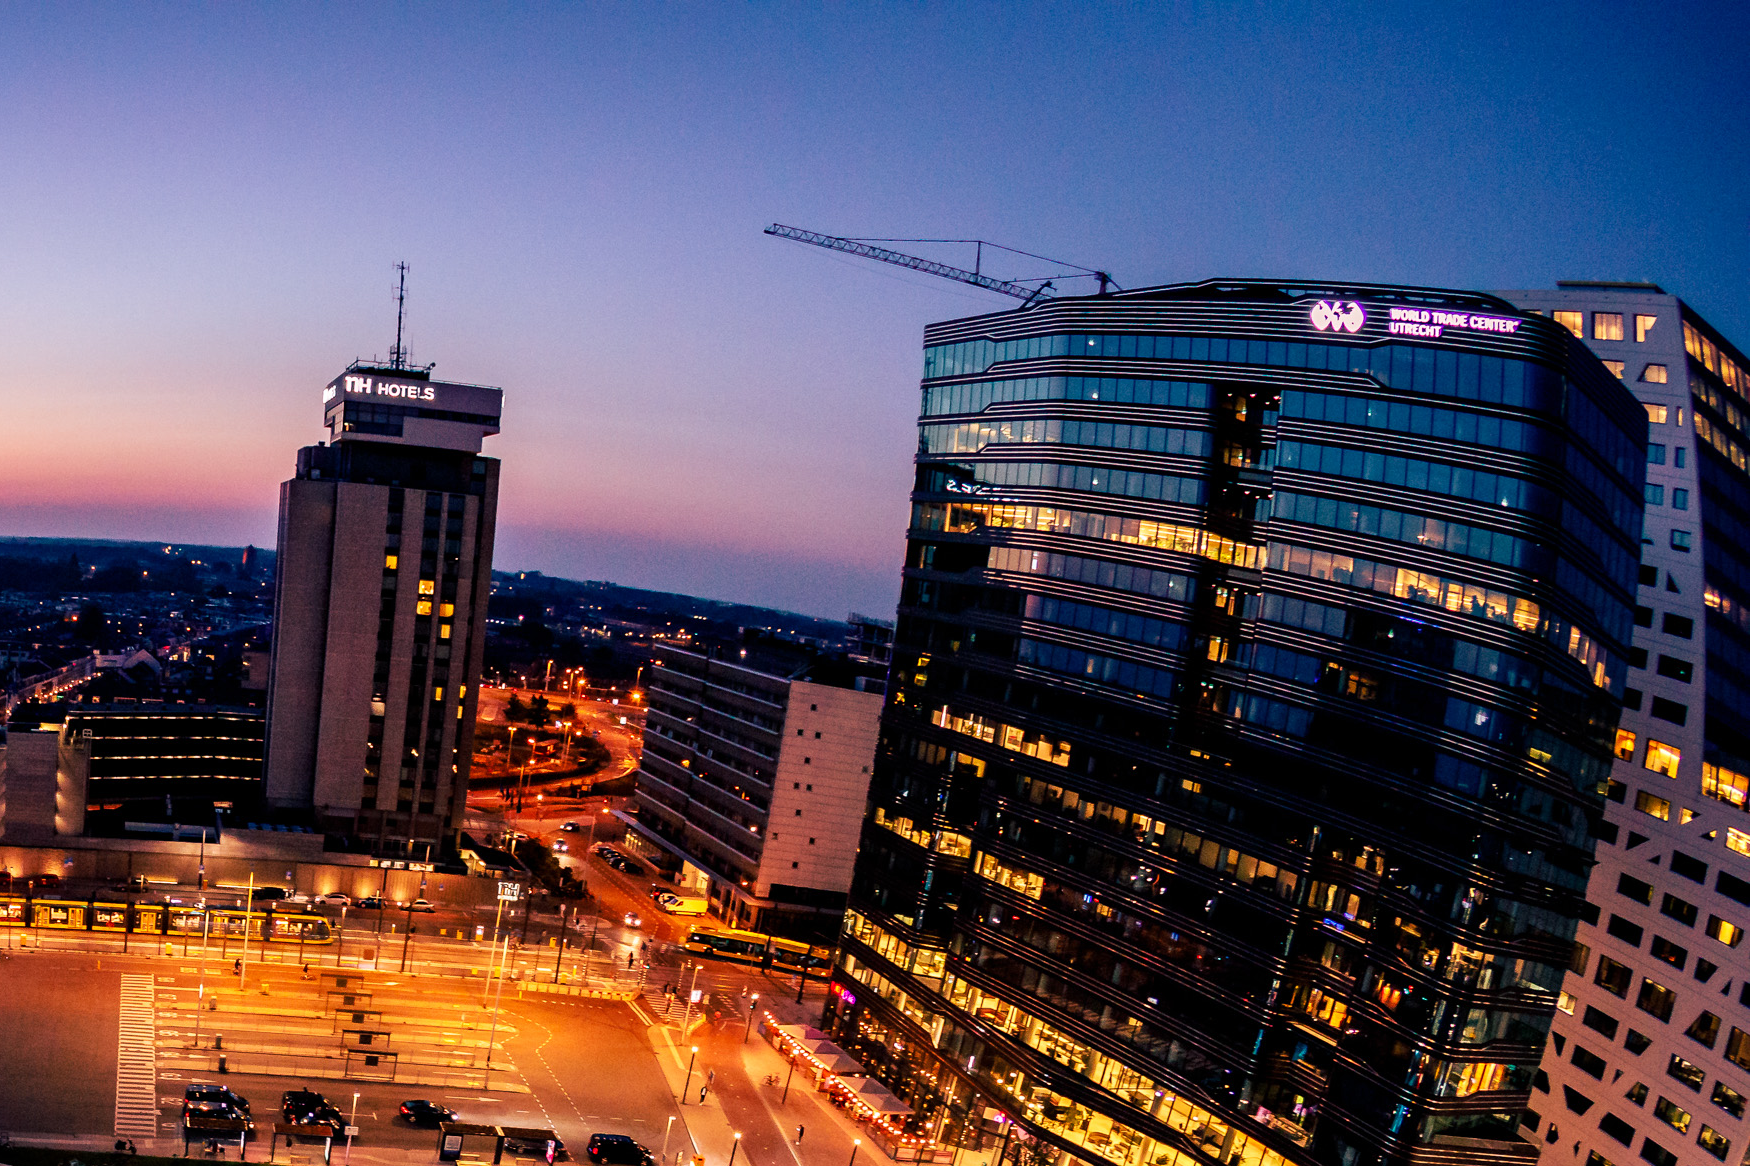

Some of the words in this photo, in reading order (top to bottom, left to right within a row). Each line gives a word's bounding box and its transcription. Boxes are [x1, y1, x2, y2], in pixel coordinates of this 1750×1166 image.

[1389, 308, 1430, 323] WORLD
[1432, 312, 1468, 327] TRADE
[1389, 322, 1443, 338] UTRECHT
[378, 383, 435, 400] HOTELS
